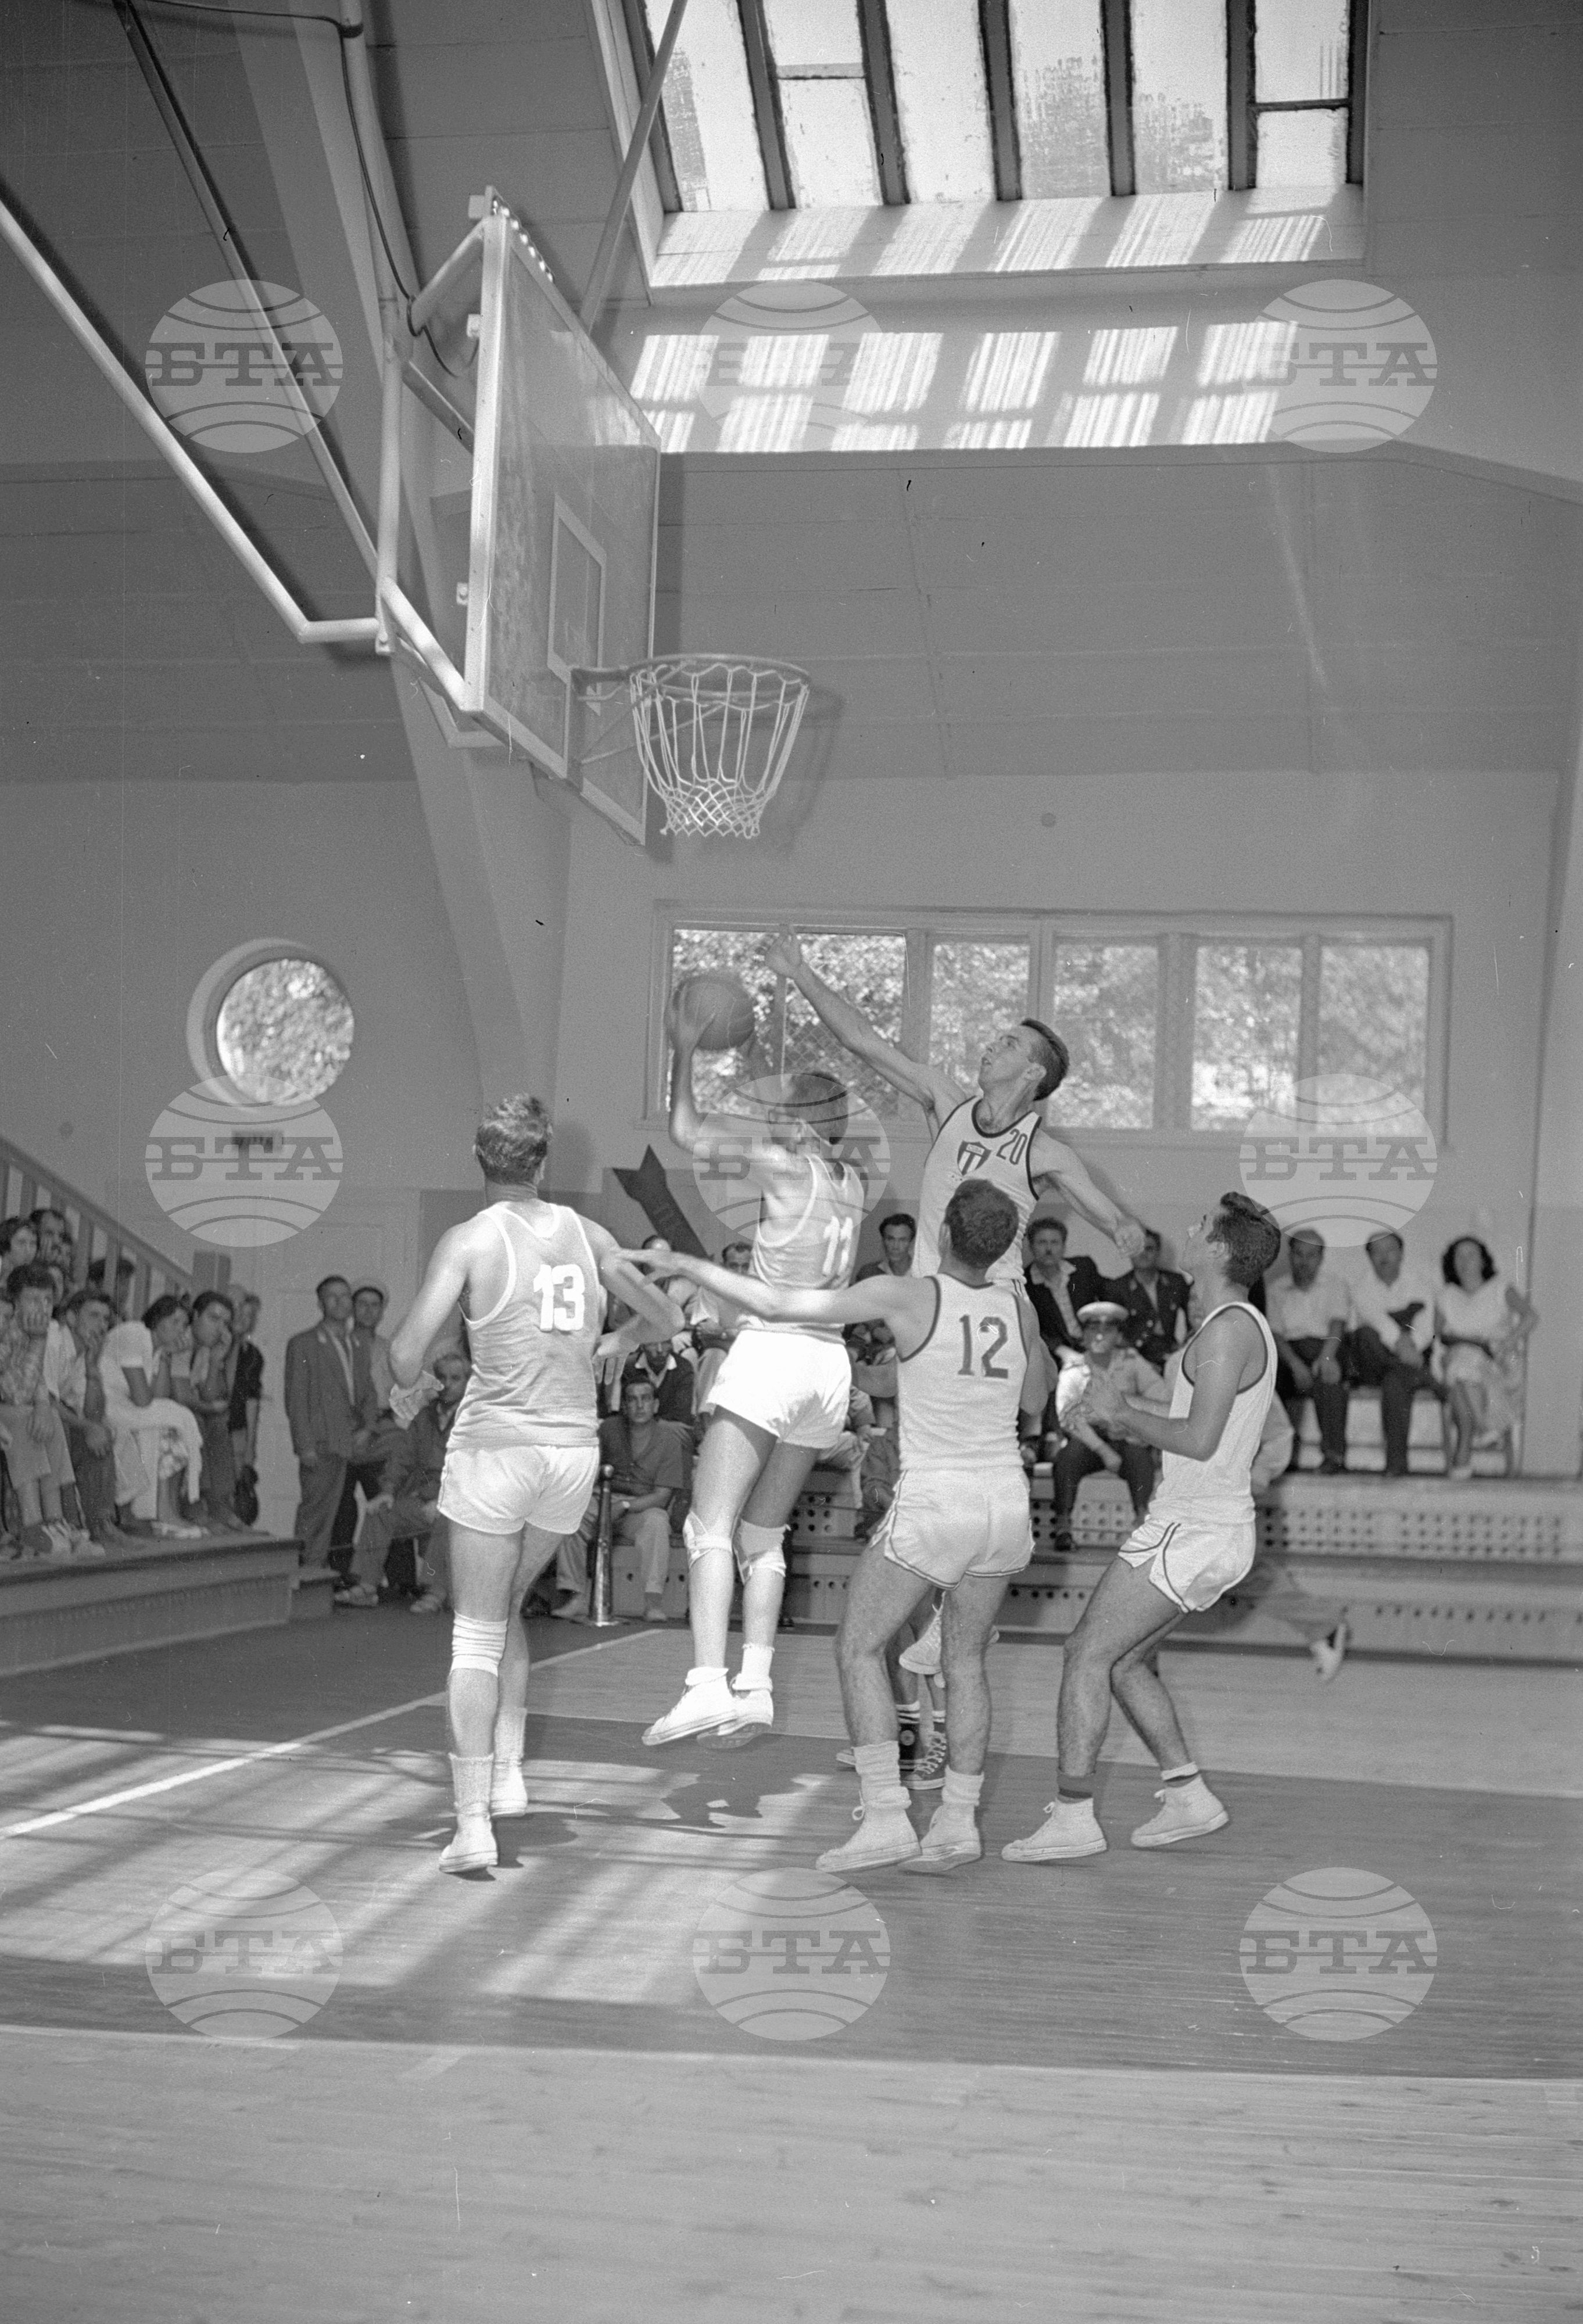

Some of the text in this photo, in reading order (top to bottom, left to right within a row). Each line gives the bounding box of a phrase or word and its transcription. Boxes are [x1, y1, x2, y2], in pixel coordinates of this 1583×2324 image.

[996, 1128, 1028, 1165] 20
[822, 1216, 853, 1276] 11
[533, 1264, 585, 1331] 13
[958, 1314, 1009, 1379] 12
